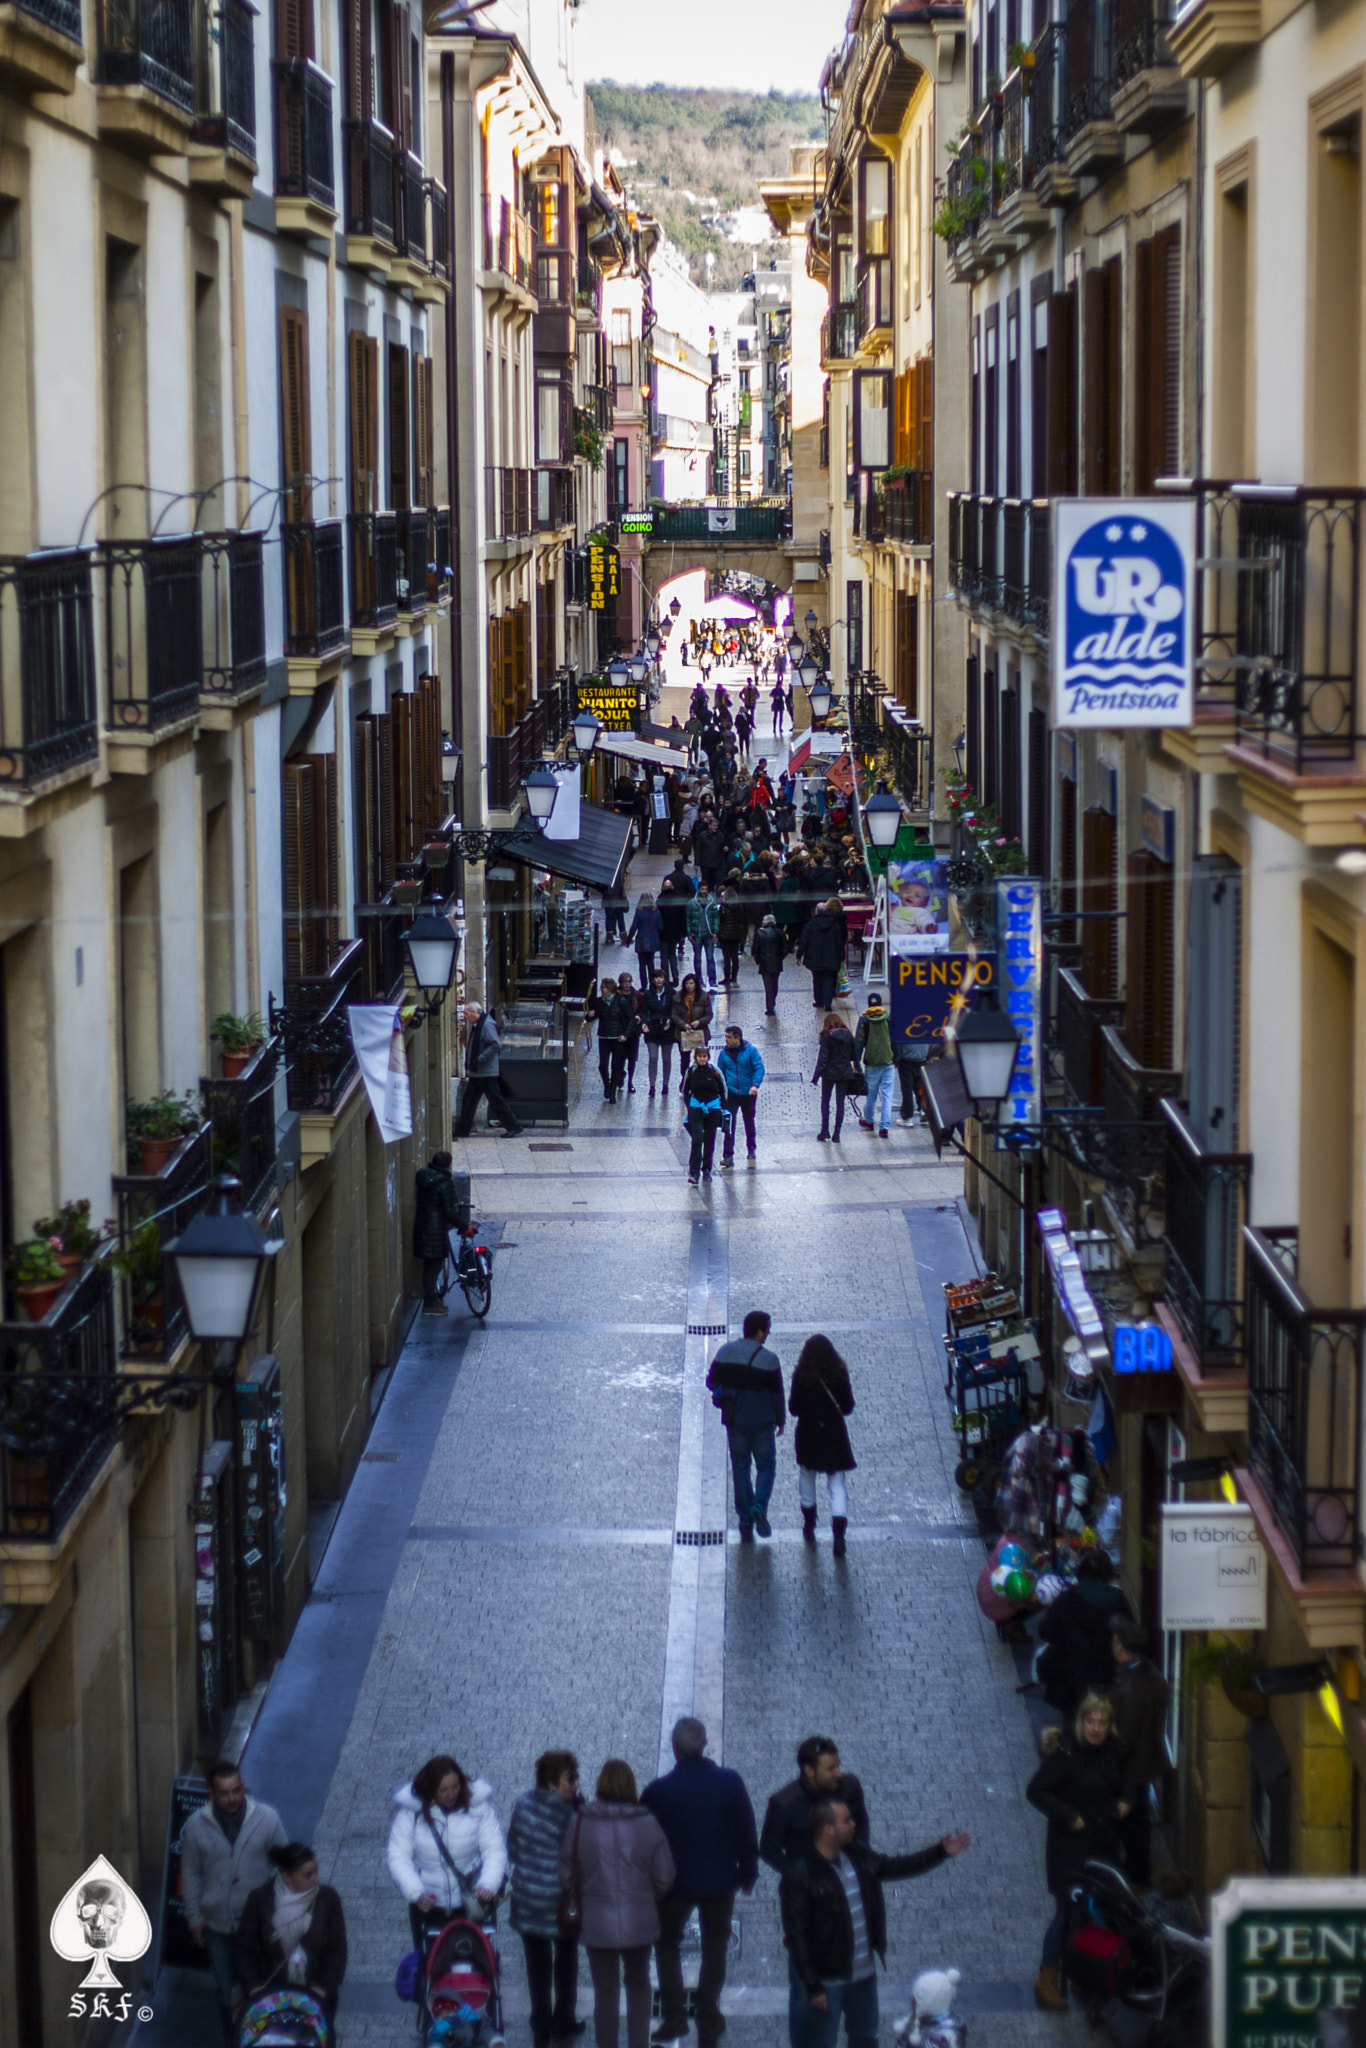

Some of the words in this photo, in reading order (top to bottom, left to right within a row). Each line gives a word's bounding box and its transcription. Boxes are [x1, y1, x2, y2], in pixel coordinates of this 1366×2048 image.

[621, 513, 653, 522] PENSION
[622, 522, 653, 532] GOIKO
[590, 546, 605, 609] PENSION
[608, 554, 618, 595] KAIA
[1073, 617, 1177, 661] alde
[577, 687, 637, 697] RESTAURANTE
[577, 697, 637, 709] JUANITO
[591, 709, 631, 720] OJUA
[1005, 885, 1035, 1143] CERVECERI
[1170, 1527, 1187, 1543] la
[1242, 1924, 1366, 1965] PEN
